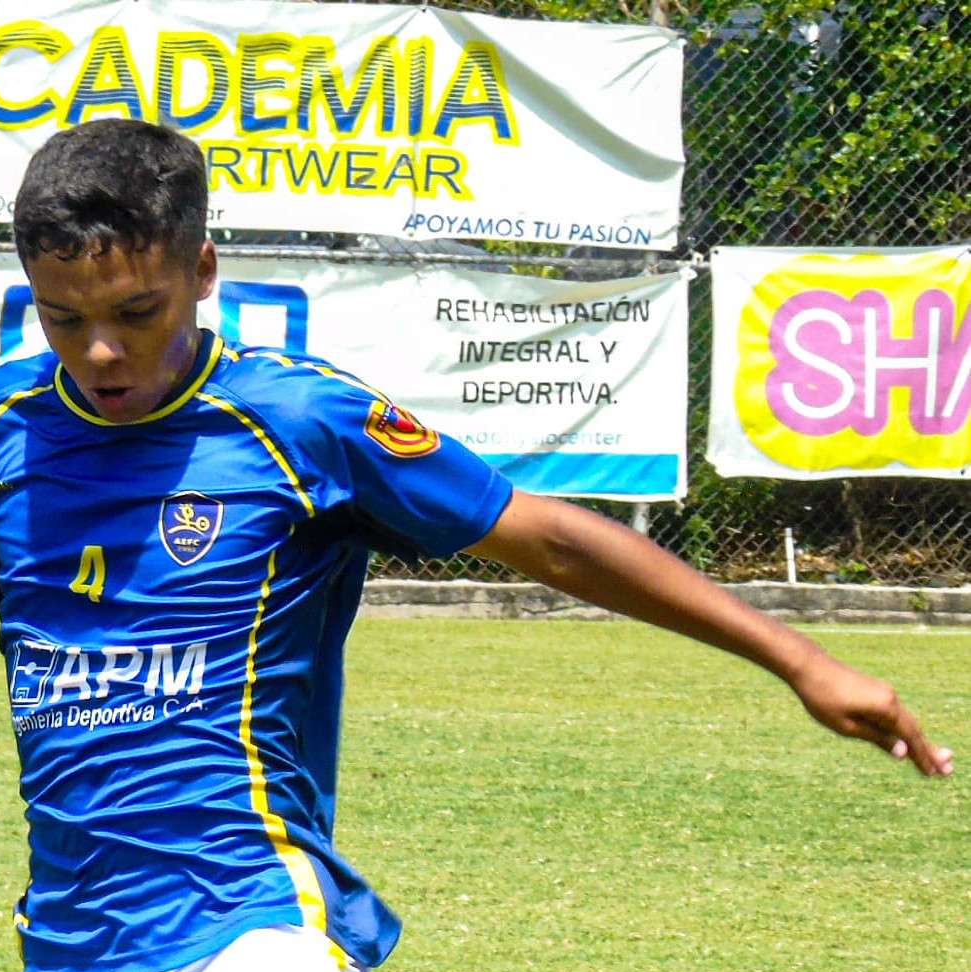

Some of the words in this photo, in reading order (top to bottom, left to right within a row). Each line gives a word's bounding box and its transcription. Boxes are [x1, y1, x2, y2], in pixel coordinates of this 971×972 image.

[208, 146, 462, 194] RTWEAR
[403, 213, 524, 238] APOYAMOS
[533, 221, 562, 241] TU
[436, 296, 650, 324] REHABILITACIÓN
[459, 340, 589, 364] INTEGRAL
[601, 341, 618, 363] Y
[462, 381, 618, 404] DEPORTIVA.
[69, 545, 106, 602] 4
[49, 642, 208, 703] APM
[66, 702, 156, 731] Deportiva
